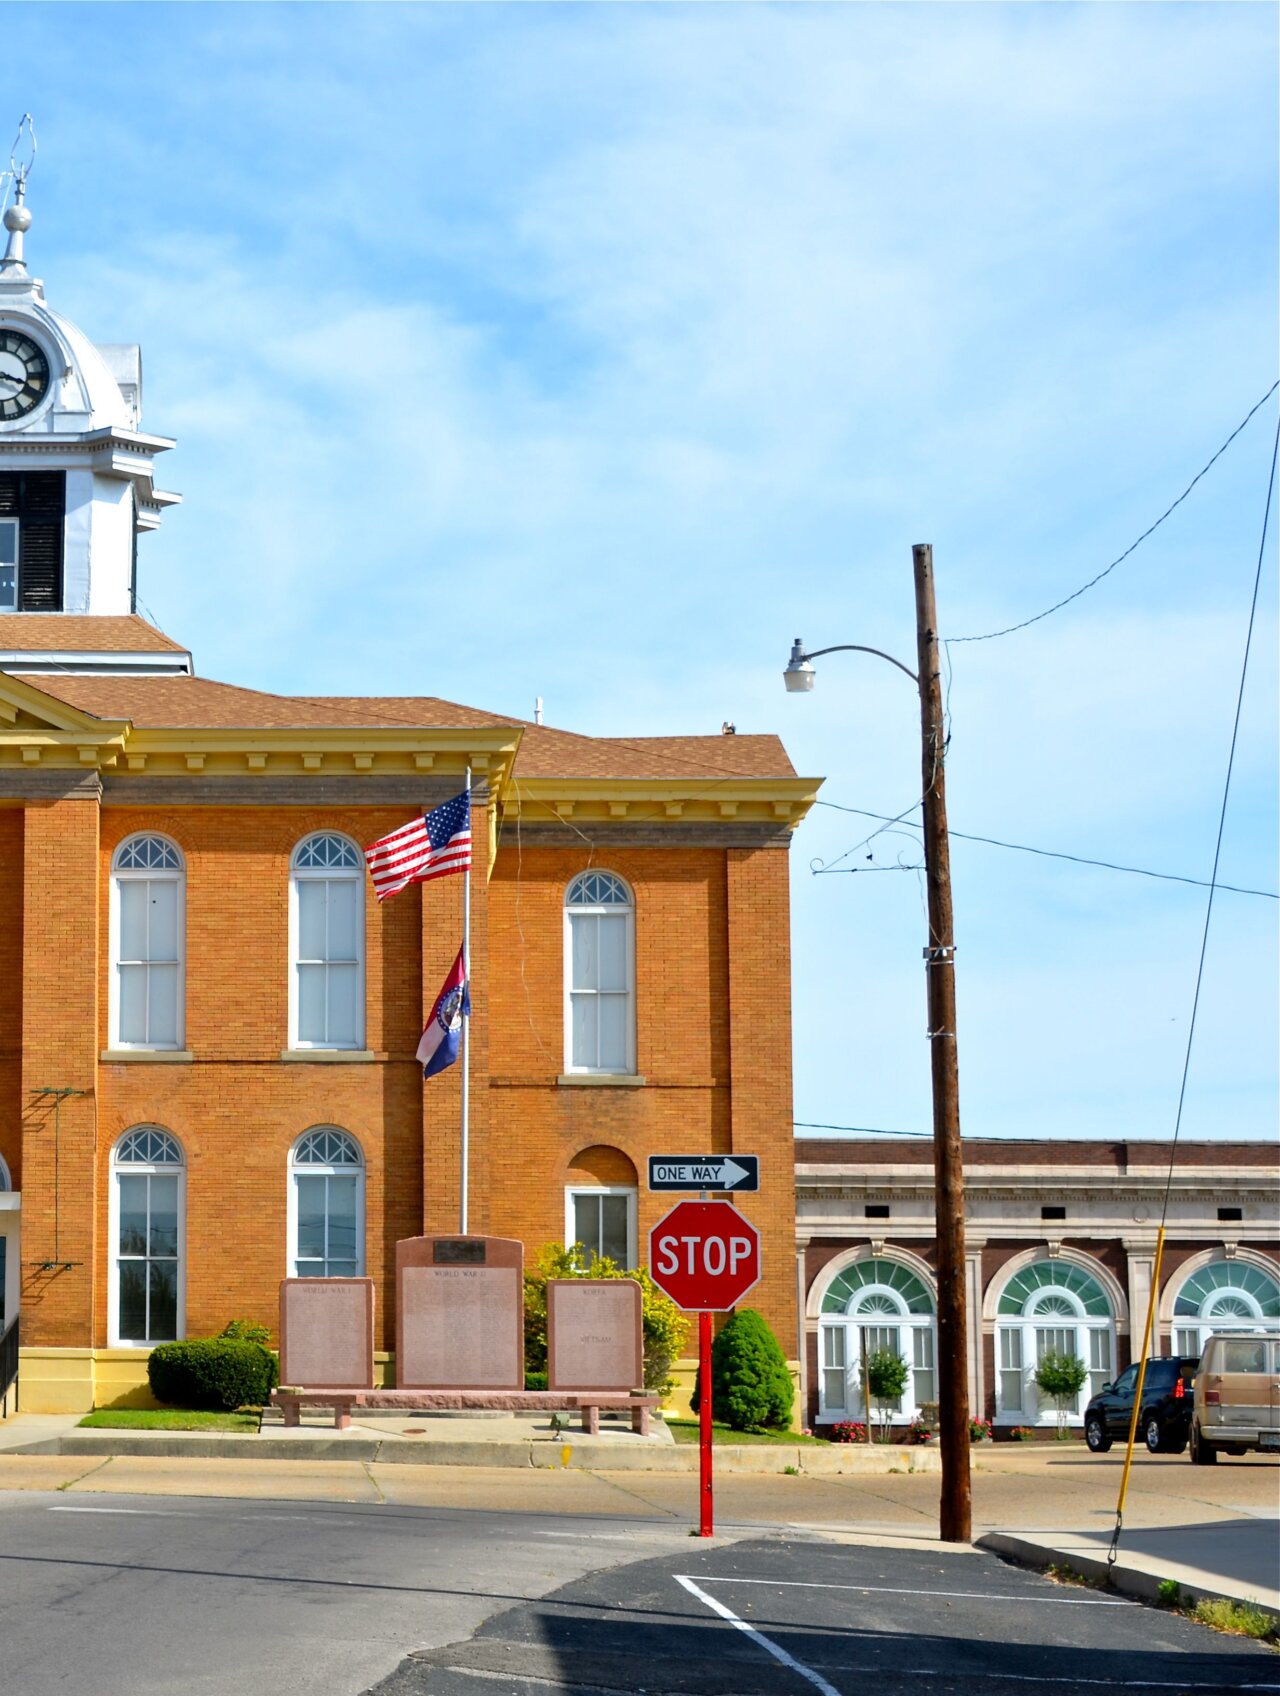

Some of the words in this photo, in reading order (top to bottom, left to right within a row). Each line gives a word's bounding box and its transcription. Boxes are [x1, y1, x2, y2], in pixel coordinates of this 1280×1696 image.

[657, 1166, 687, 1180] ONE
[691, 1166, 722, 1180] WAY
[657, 1235, 752, 1276] STOP
[434, 1270, 460, 1278] WORLD
[462, 1270, 478, 1278] WAR
[302, 1286, 328, 1294] WORLD
[331, 1286, 346, 1294] WAR
